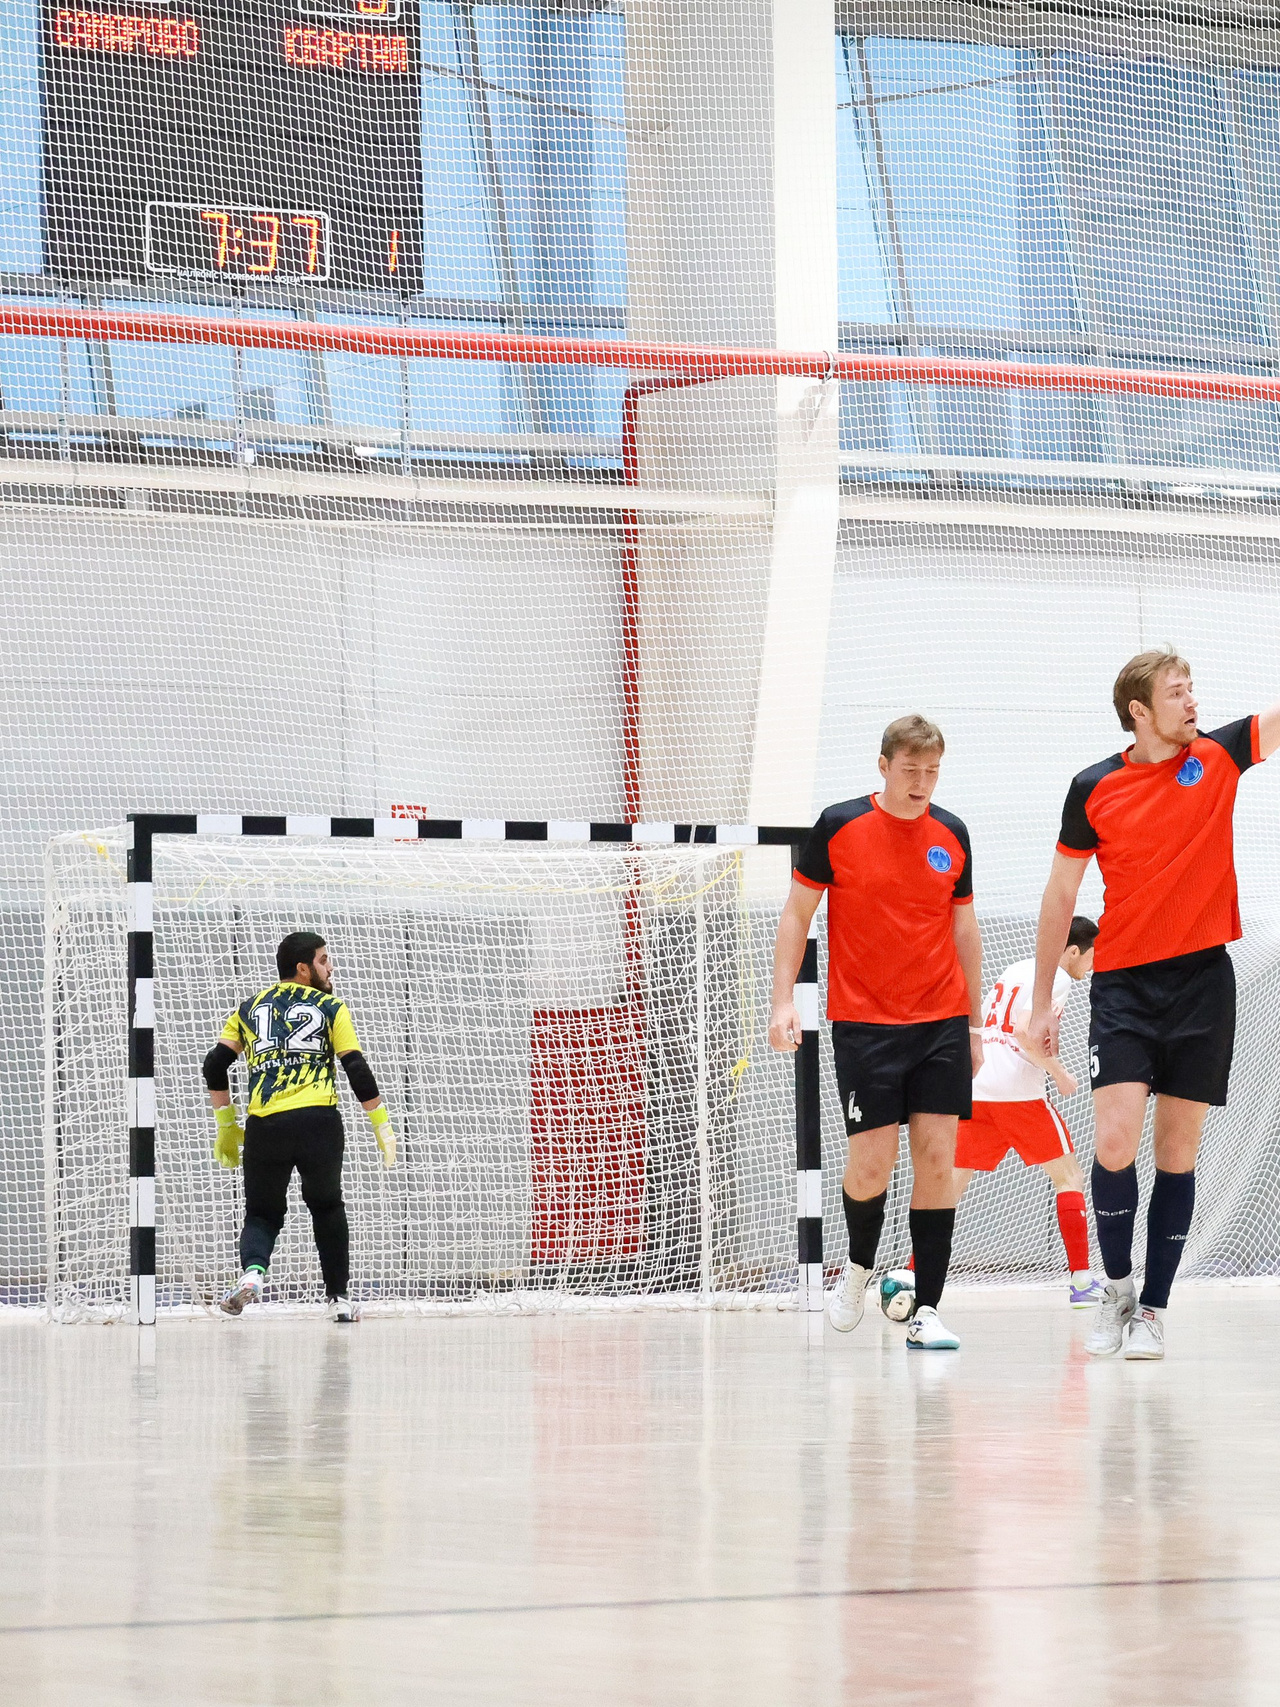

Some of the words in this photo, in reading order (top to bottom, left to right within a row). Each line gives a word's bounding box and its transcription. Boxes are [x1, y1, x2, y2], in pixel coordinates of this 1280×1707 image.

[201, 211, 319, 273] 7:37
[251, 1002, 326, 1055] 12
[983, 979, 1024, 1035] 21
[848, 1091, 862, 1122] 4
